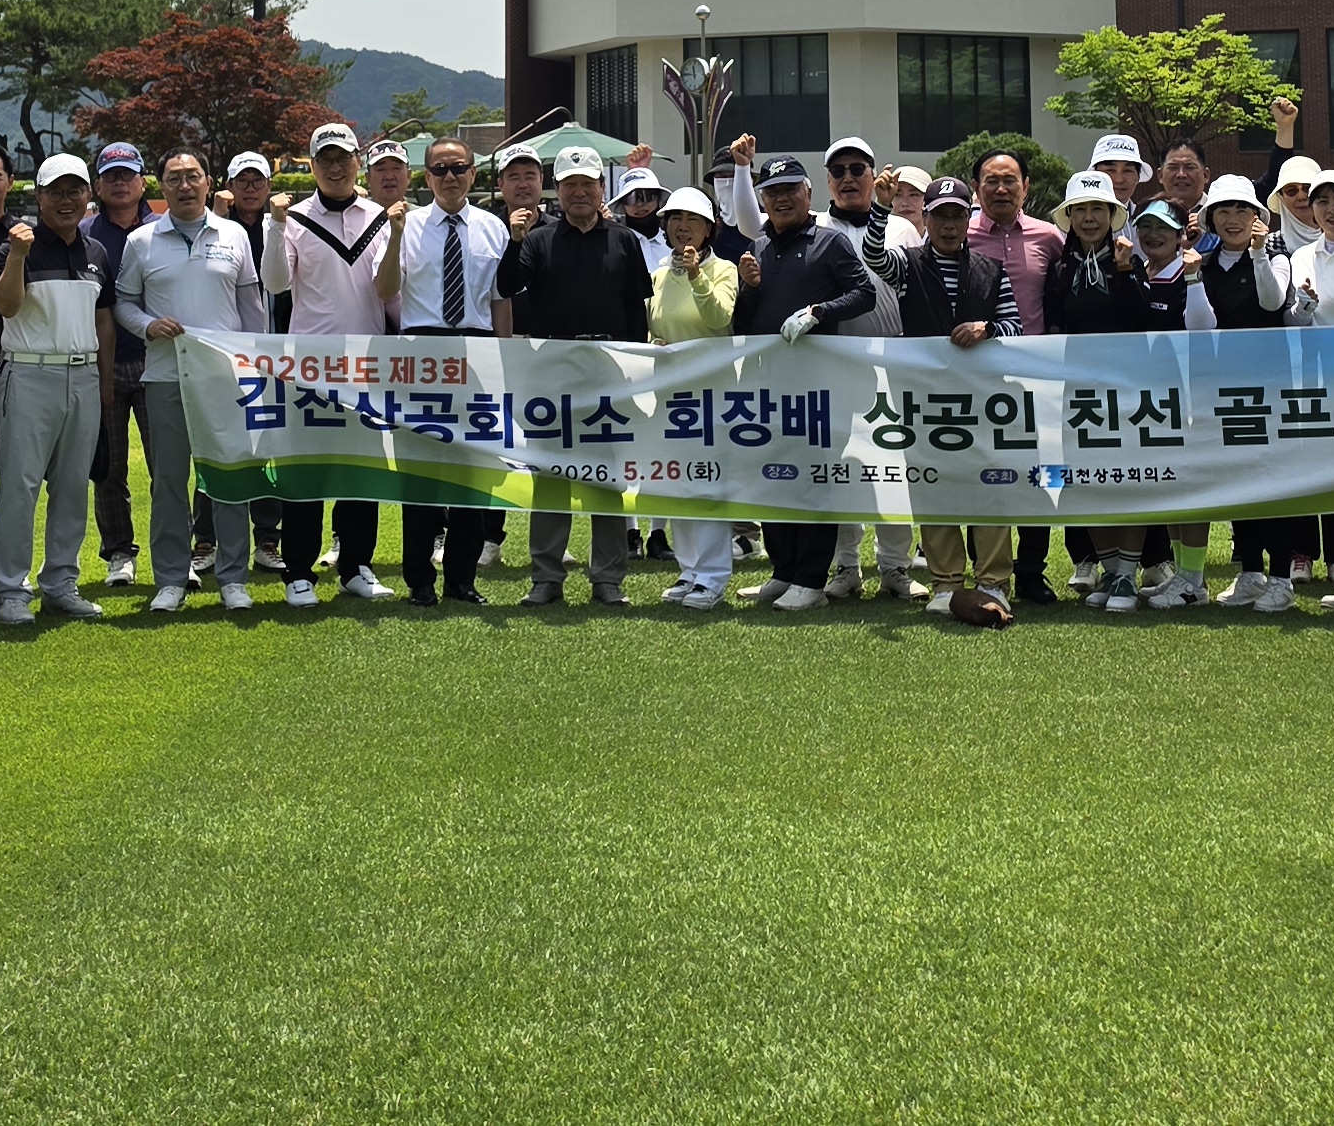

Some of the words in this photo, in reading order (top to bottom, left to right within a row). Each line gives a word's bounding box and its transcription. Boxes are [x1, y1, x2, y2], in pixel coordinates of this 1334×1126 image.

[388, 356, 468, 385] 제3회
[664, 388, 832, 449] 회장배
[863, 390, 1038, 452] 상공인
[1067, 387, 1185, 449] 친선
[767, 464, 796, 478] 장소
[809, 462, 851, 485] 김천
[860, 464, 939, 485] 포도CC
[984, 469, 1014, 483] 주최
[1059, 466, 1178, 485] 김천상공회의소
